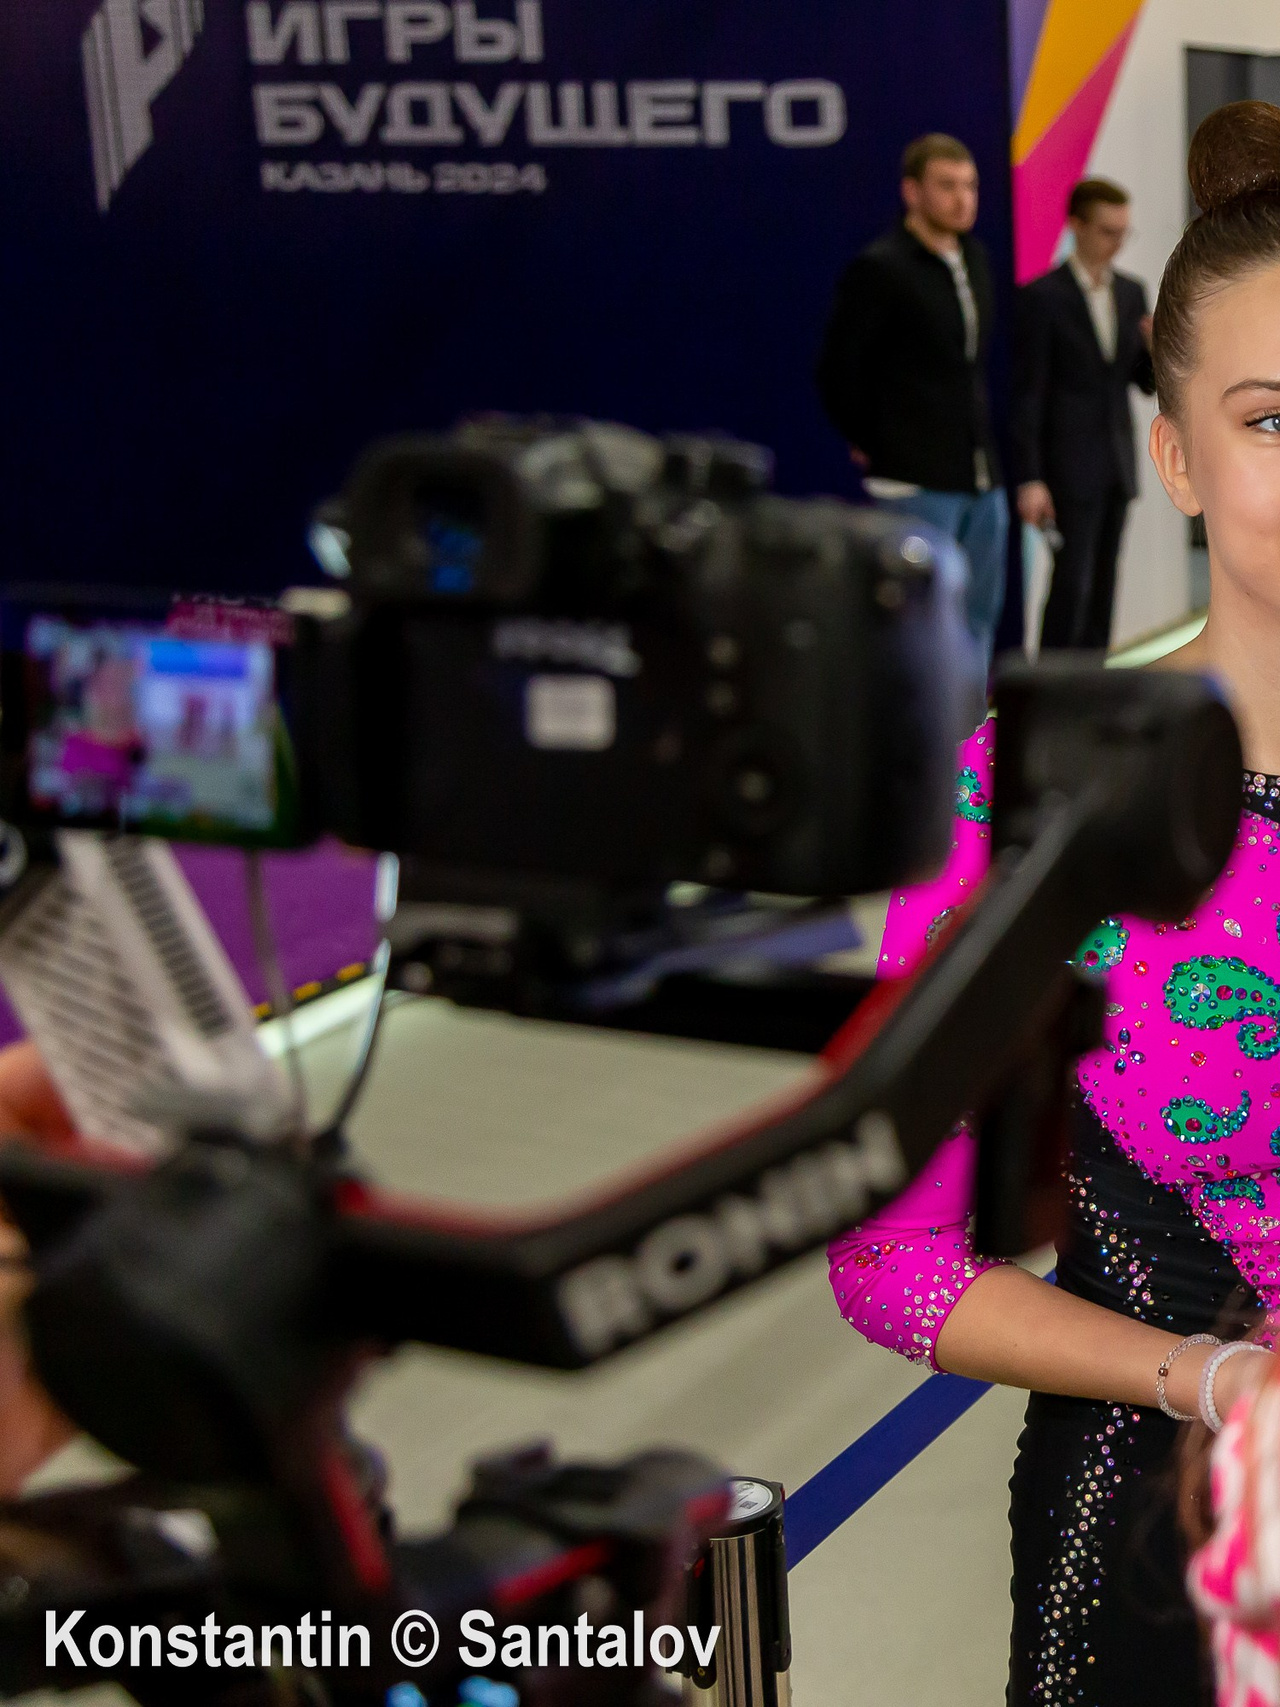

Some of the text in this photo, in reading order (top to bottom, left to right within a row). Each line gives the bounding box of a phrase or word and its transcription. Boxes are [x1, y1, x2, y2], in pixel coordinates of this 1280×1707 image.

[247, 0, 543, 64] ИГРЫ
[252, 80, 847, 147] БУДУЩЕГО
[261, 161, 547, 194] КАЗАНЬ 2024
